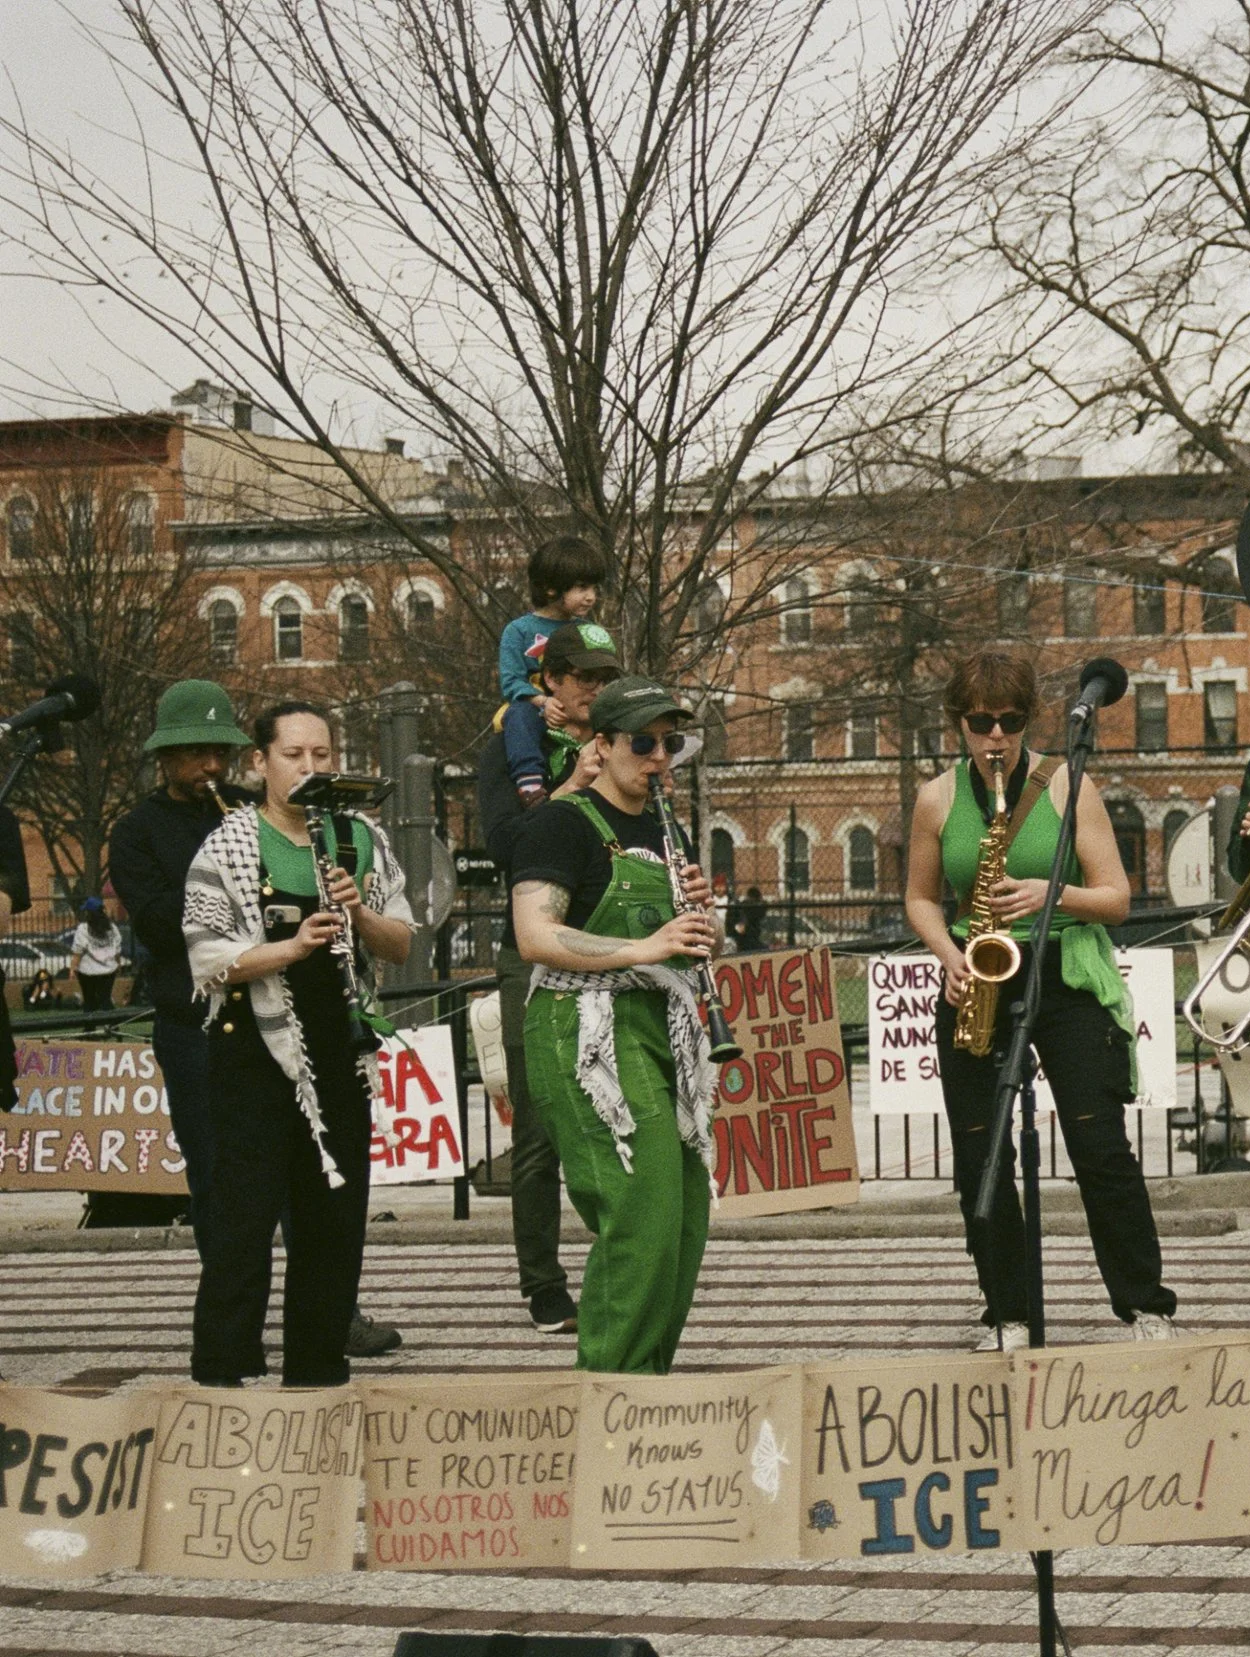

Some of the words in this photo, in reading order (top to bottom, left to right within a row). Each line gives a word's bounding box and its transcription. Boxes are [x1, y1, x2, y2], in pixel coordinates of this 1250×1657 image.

[697, 946, 835, 1026] OMEN
[751, 1018, 806, 1049] THE
[93, 1049, 156, 1079] HAS
[713, 1047, 846, 1110] ORLD
[881, 1058, 906, 1082] DE
[93, 1085, 126, 1116] IN
[0, 1127, 188, 1174] HEARTS
[158, 1400, 364, 1477] ABOLISH
[426, 1405, 575, 1444] COMUNIDAD
[604, 1391, 759, 1454] Community
[815, 1382, 1013, 1475] ABOLISH
[373, 1457, 422, 1489] TE
[441, 1452, 576, 1489] PROTEGE!
[373, 1491, 515, 1528] NOSOTROS
[533, 1490, 569, 1519] NOS
[601, 1483, 632, 1514] NO
[859, 1468, 1000, 1557] ICE
[184, 1484, 321, 1565] ICE
